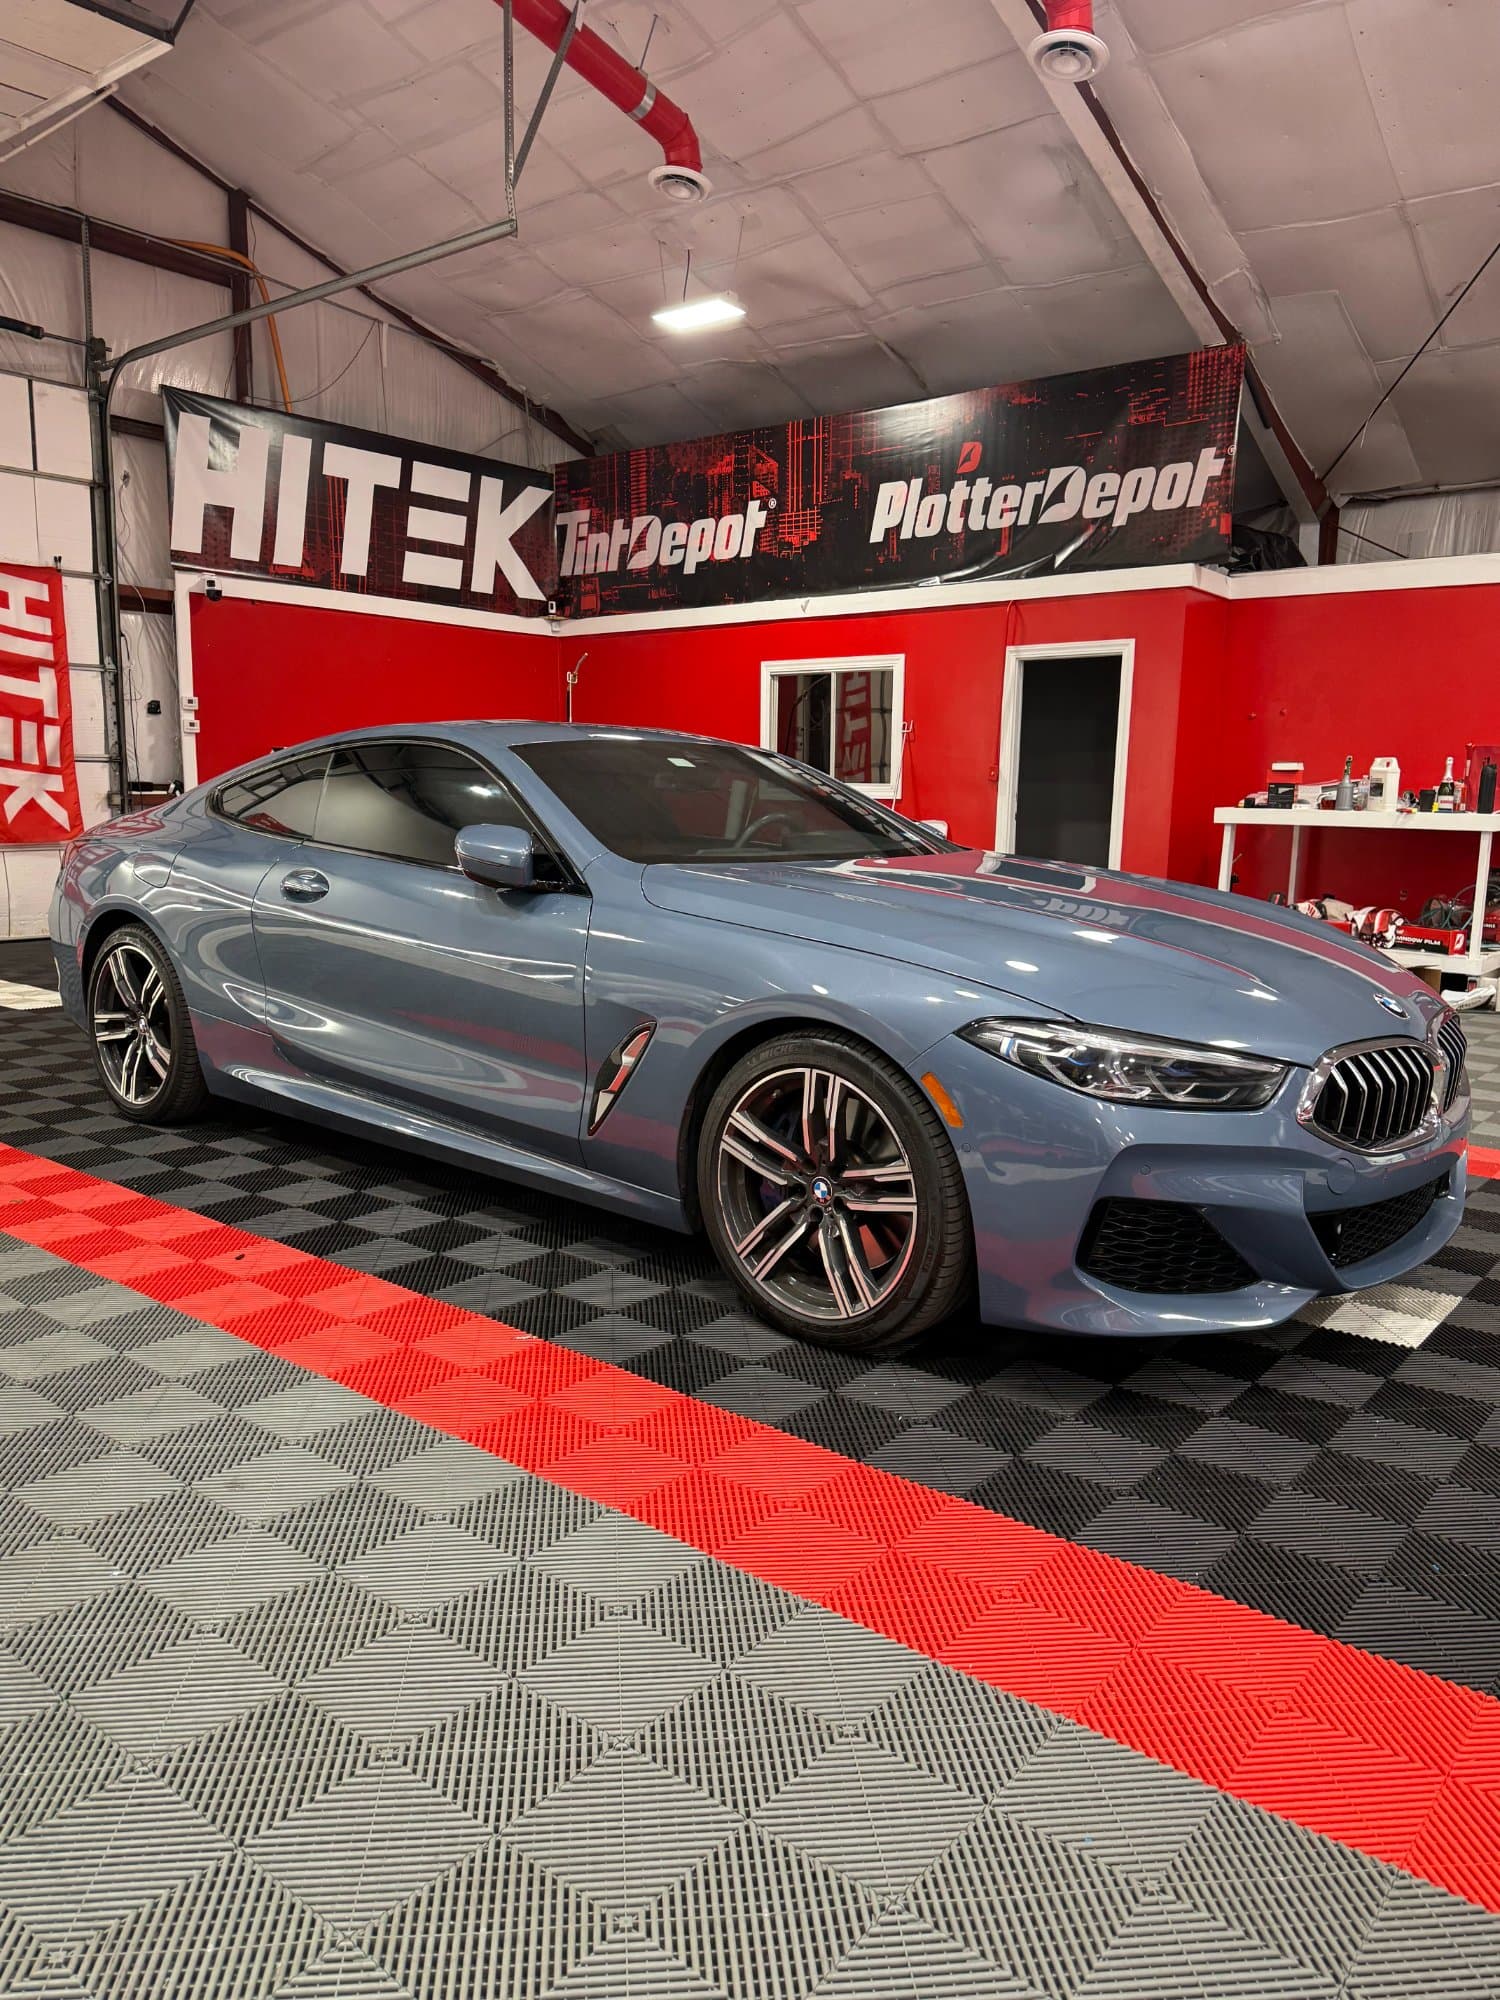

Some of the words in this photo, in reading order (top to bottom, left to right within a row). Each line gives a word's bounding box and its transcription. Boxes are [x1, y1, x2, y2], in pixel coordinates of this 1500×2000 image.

[170, 411, 555, 601] HITEK
[556, 500, 768, 577] TintDepot
[869, 447, 1226, 544] PlotterDepot
[0, 571, 71, 832] HITEK
[1396, 935, 1423, 944] WINDOW
[1423, 938, 1441, 946] FILM
